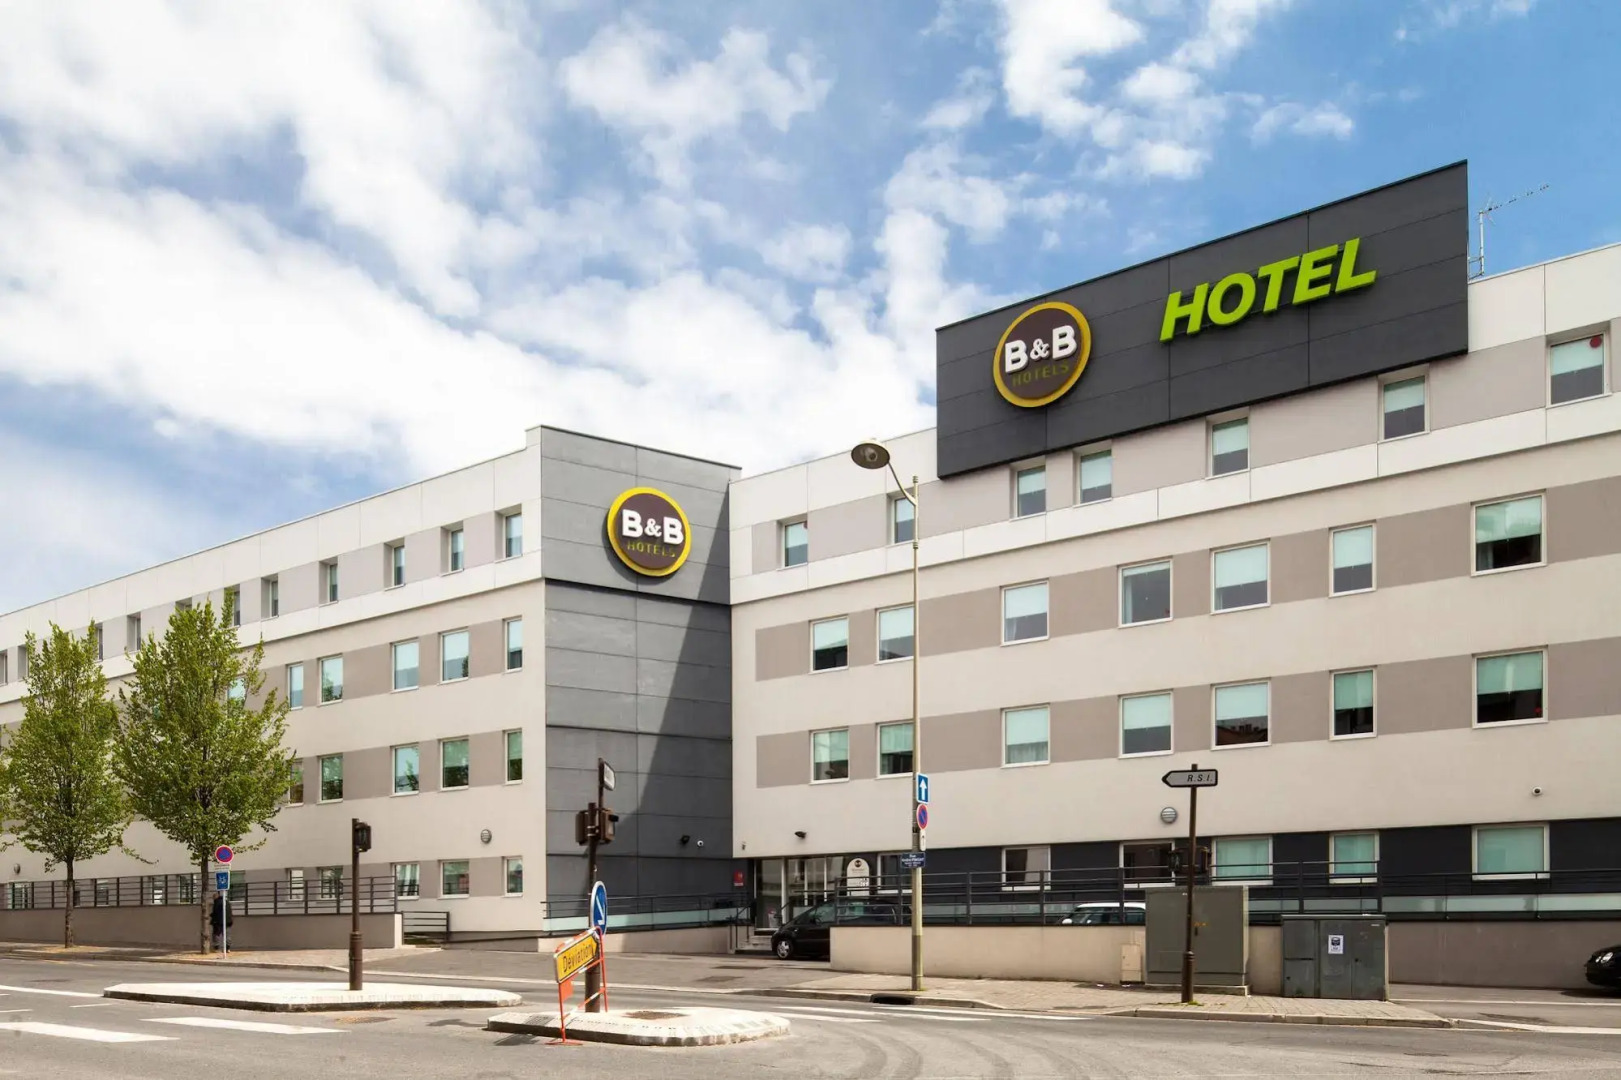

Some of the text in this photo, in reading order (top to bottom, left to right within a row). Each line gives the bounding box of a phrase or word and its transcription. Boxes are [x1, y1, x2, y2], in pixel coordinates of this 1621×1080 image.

[1159, 237, 1377, 342] HOTEL
[1005, 325, 1077, 373] B&B
[1012, 361, 1069, 386] HOTELS
[622, 509, 684, 544] B&B
